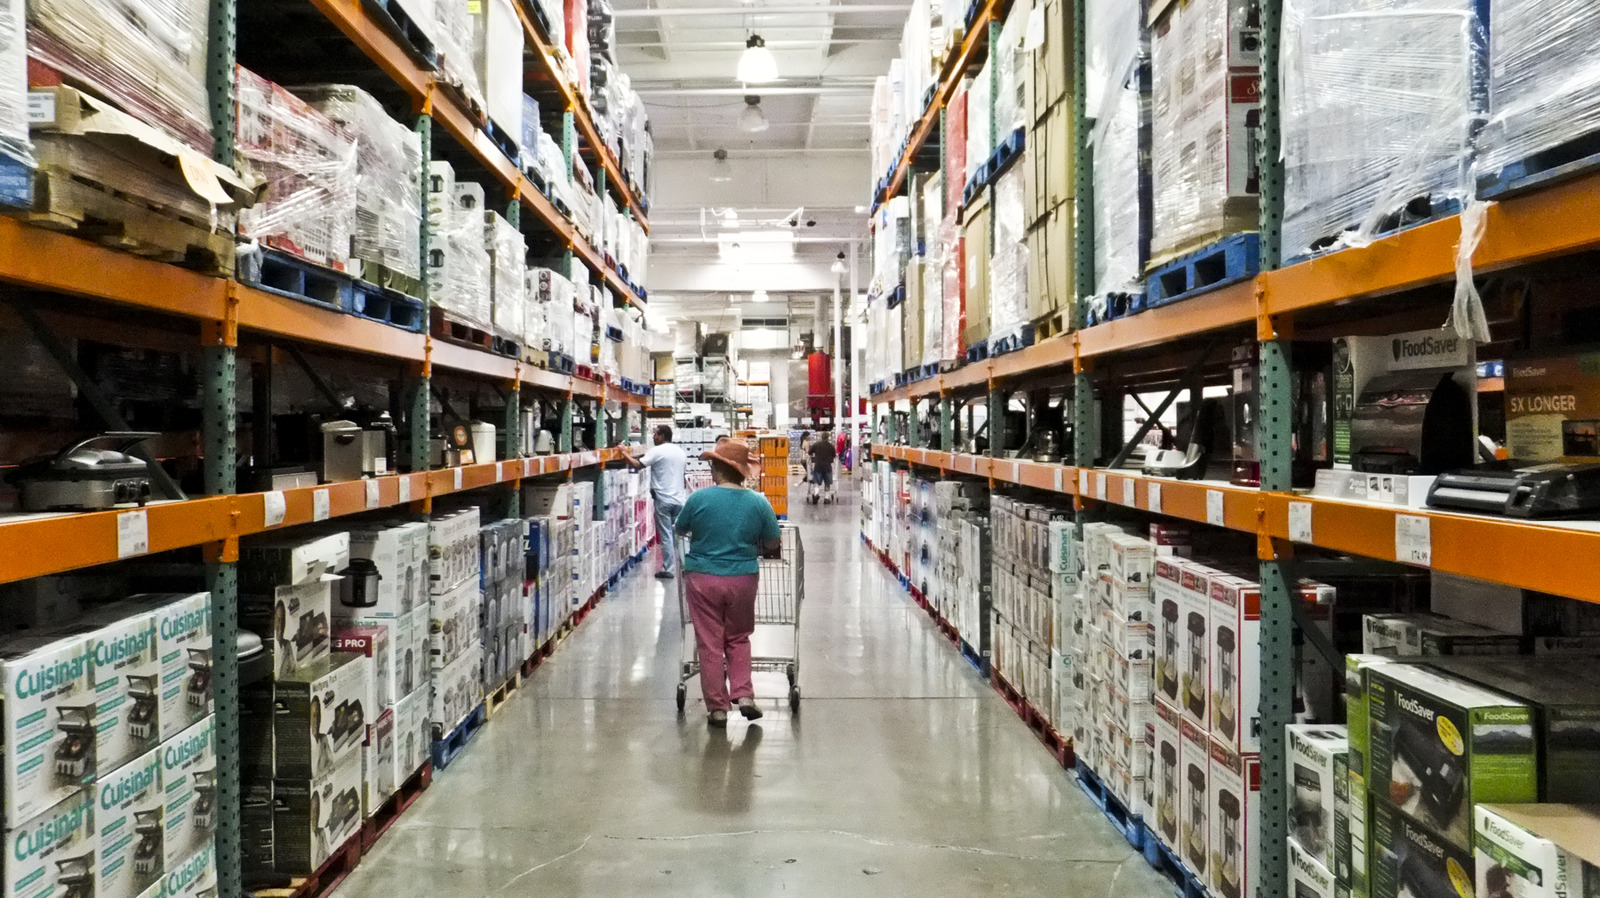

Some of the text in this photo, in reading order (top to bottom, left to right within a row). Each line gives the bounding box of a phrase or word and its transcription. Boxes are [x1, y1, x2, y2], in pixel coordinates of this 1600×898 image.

[1402, 336, 1459, 357] FoodSaver
[1528, 395, 1576, 412] LONGER
[161, 604, 211, 640] Cuisinart
[95, 626, 157, 667] Cuisinart
[345, 639, 366, 648] PRO
[15, 649, 95, 699] Cuisinart
[1398, 693, 1434, 721] FoodSaver
[1484, 712, 1529, 720] FoodSaver
[165, 719, 215, 770] Cuisinart
[1296, 735, 1327, 768] FoodSaver
[101, 758, 163, 810] Cuisinart
[15, 797, 95, 861] Cuisinart
[1406, 824, 1444, 858] FoodSaver
[1489, 821, 1525, 849] FoodSaver
[1296, 853, 1329, 890] FoodSaver
